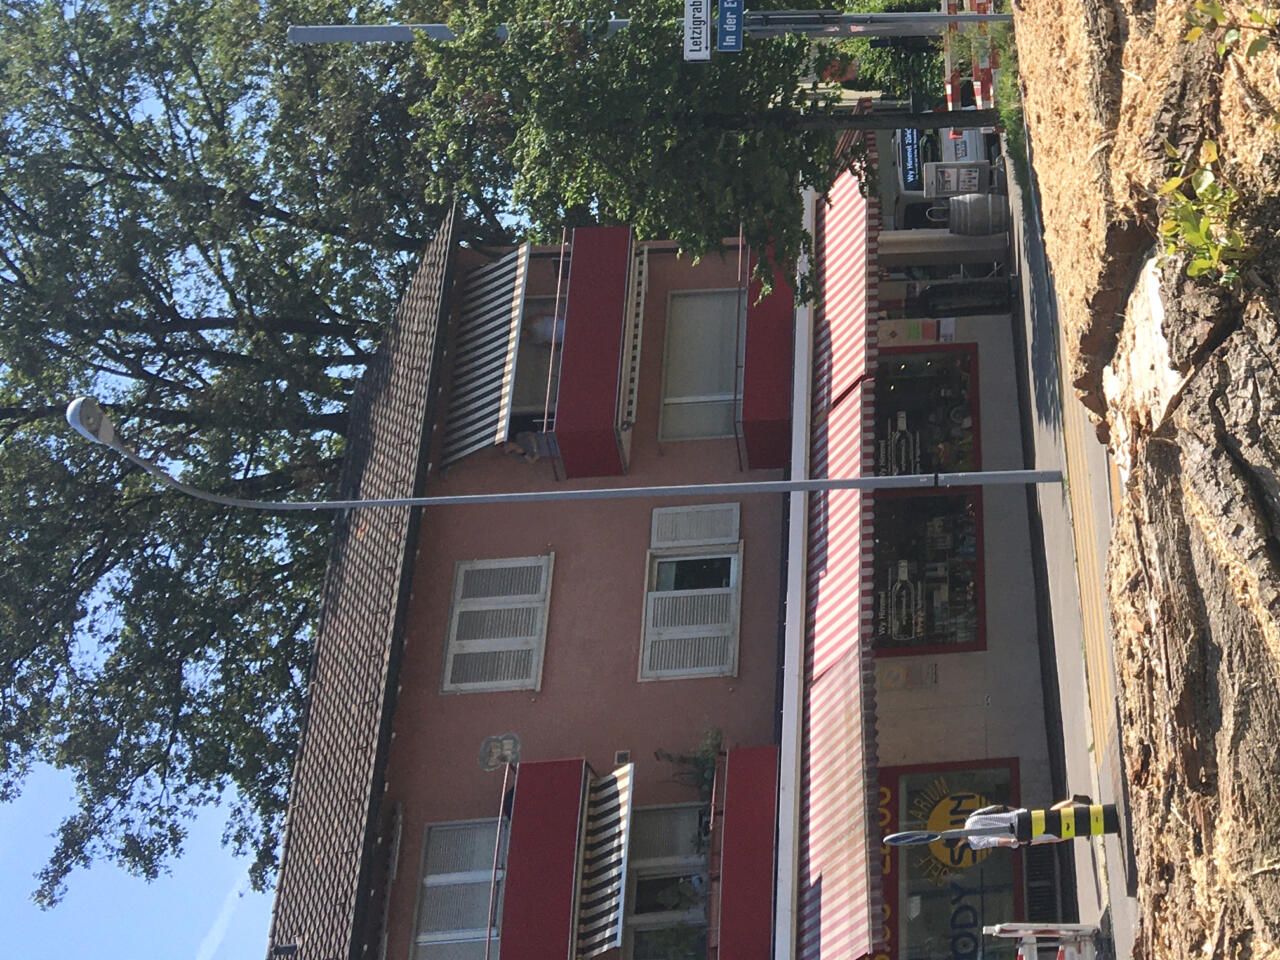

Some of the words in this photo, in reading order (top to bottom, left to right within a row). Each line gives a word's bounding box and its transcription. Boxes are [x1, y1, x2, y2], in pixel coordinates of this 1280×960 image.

[723, 12, 737, 31] der
[723, 36, 736, 46] In
[904, 128, 912, 144] Züric
[906, 145, 914, 168] Himmel
[906, 170, 914, 182] Wy
